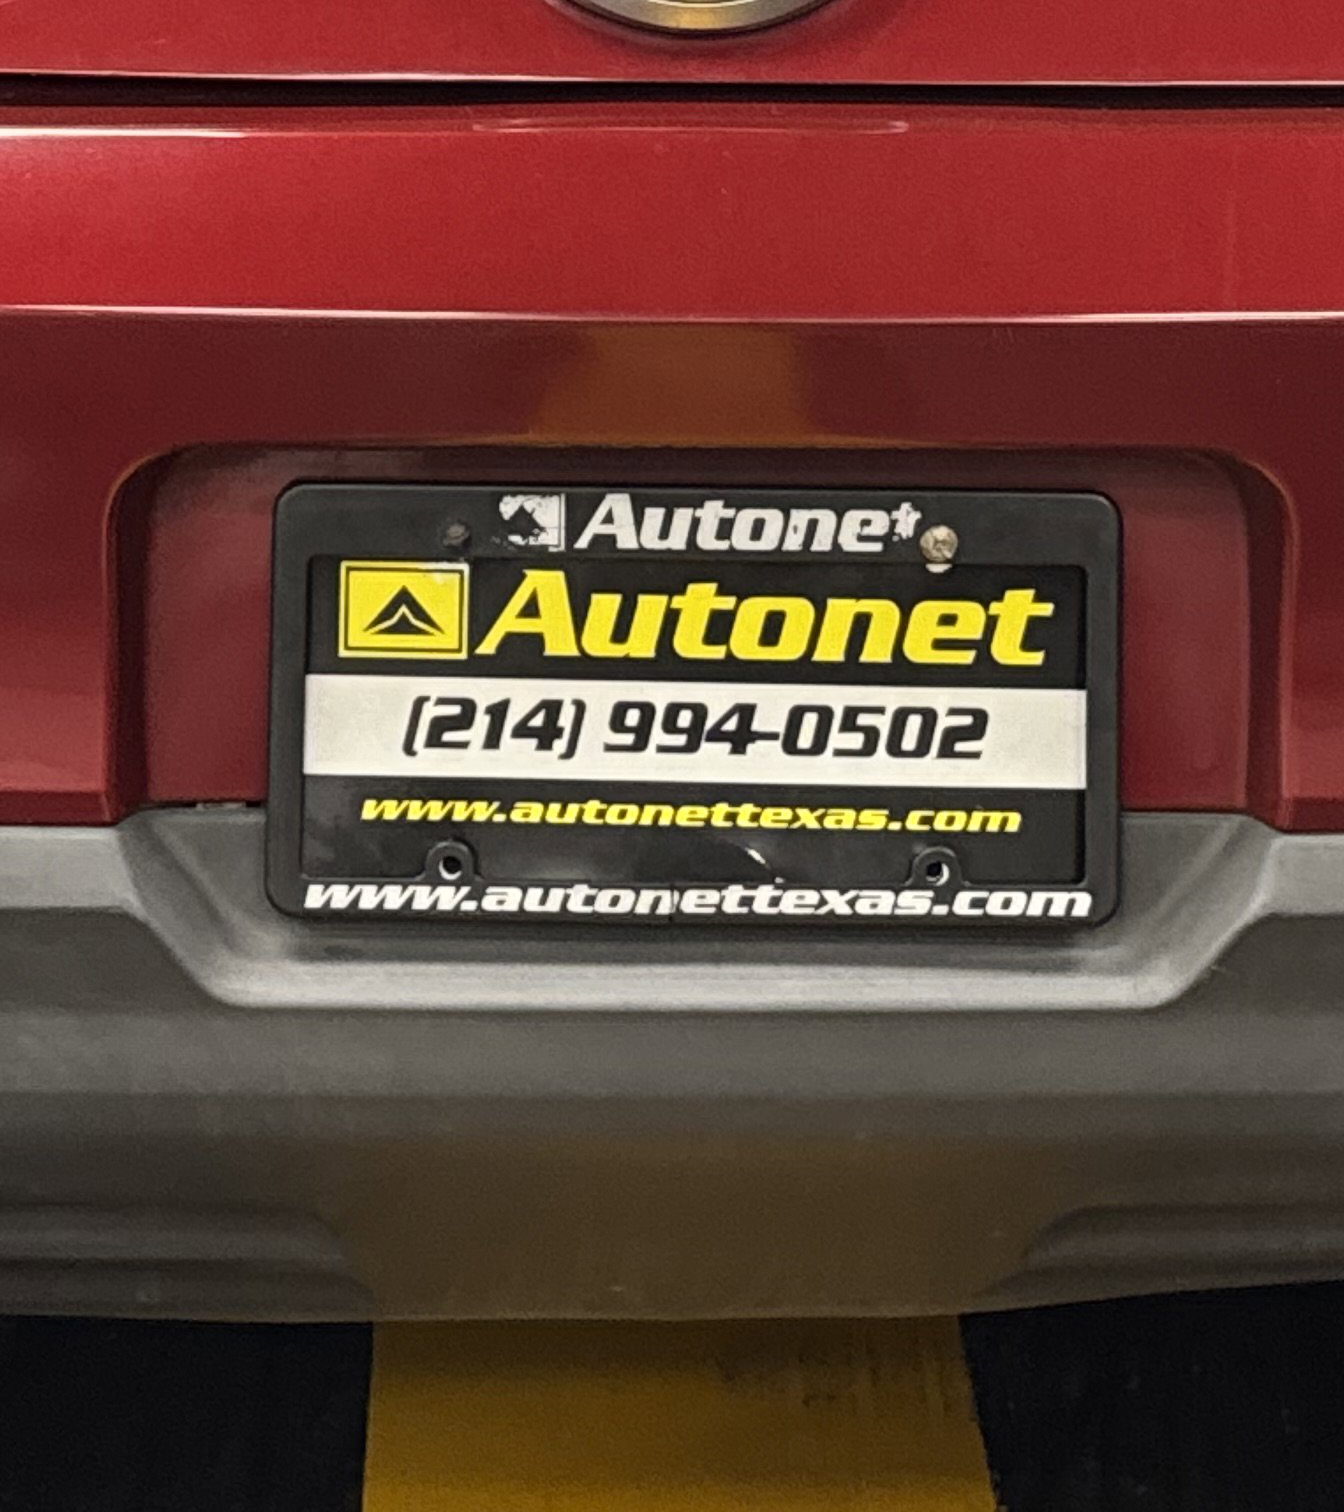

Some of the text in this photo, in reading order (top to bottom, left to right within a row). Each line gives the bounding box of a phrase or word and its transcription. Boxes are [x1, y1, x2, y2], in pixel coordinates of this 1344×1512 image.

[474, 568, 1053, 666] Autonet
[402, 696, 990, 760] (214) 994-0502
[360, 798, 1022, 833] www.autonettexas.com
[302, 883, 1094, 918] www.autonettexas.com
